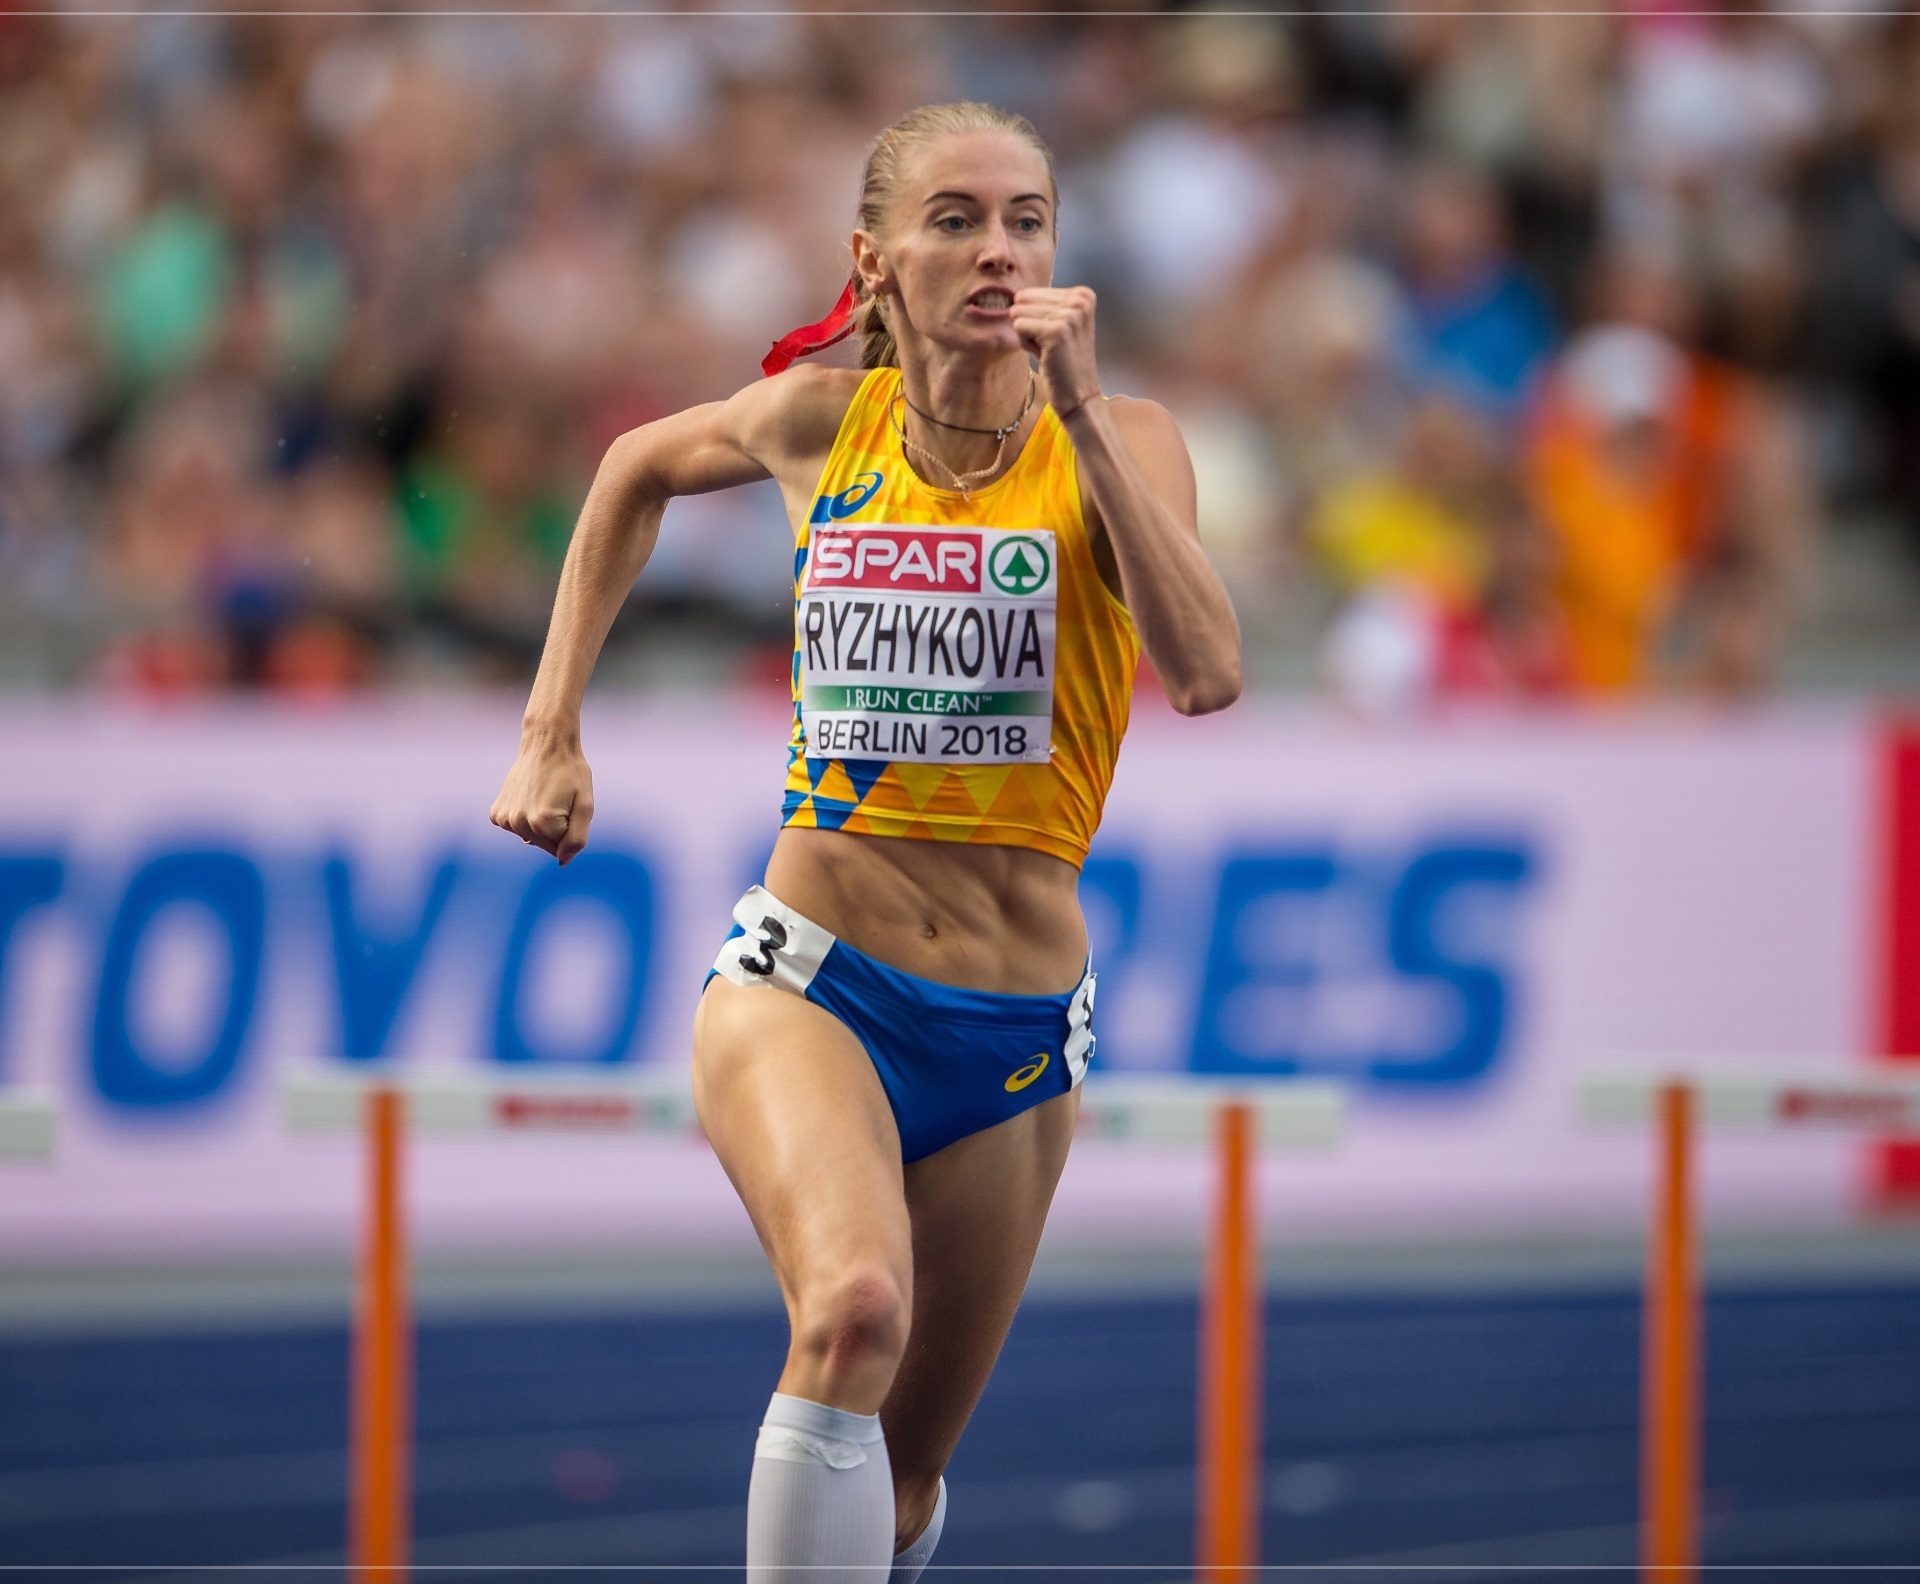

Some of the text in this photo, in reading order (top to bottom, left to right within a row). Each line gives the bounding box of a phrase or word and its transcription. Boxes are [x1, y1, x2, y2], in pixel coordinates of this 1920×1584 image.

[813, 537, 977, 585] SPAR
[805, 601, 1045, 679] RYZHYKOVA
[845, 691, 851, 708] I
[856, 689, 900, 710] RUN
[818, 719, 1027, 756] BERLIN 2018
[738, 915, 788, 976] 3
